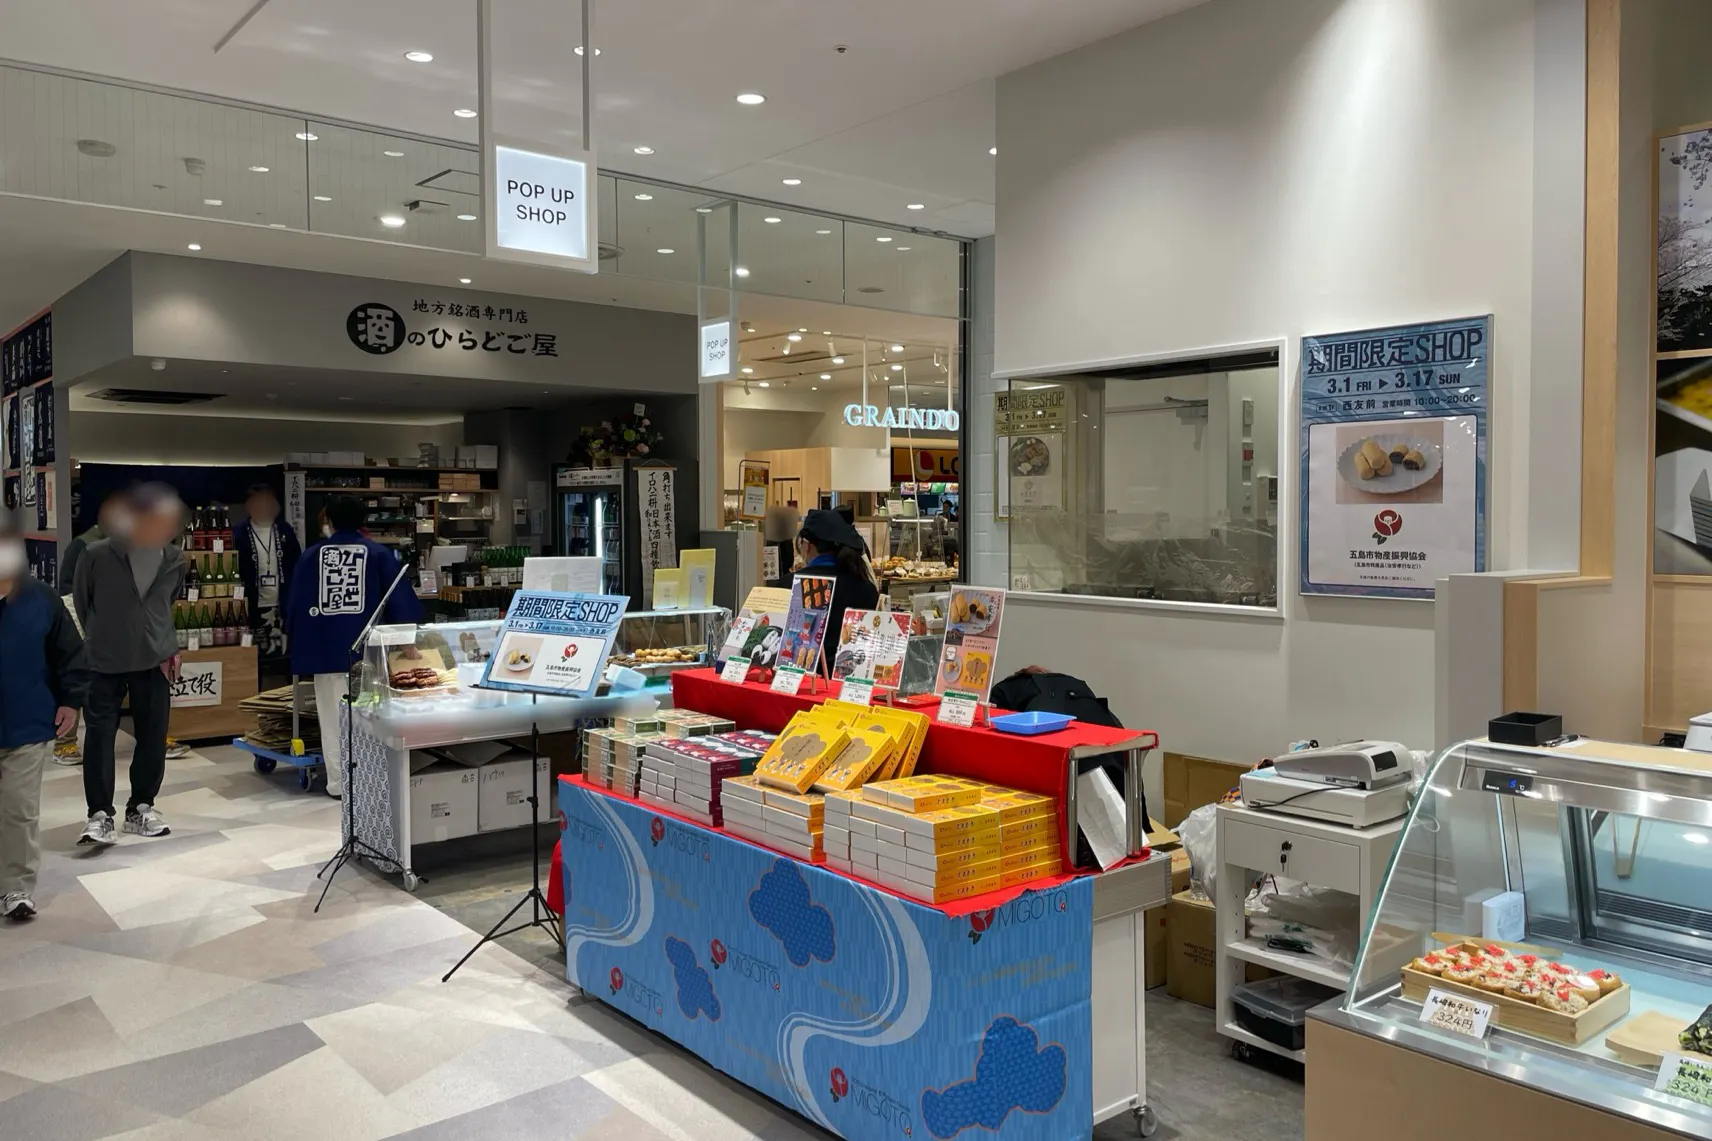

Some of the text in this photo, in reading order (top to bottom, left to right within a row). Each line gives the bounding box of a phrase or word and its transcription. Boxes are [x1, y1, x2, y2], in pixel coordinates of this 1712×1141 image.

[507, 179, 575, 204] POP UP
[516, 204, 567, 225] SHOP
[412, 299, 529, 324] 地方銘酒専門店
[707, 338, 729, 349] POP UP
[1307, 328, 1483, 374] 期間限定SHOP
[709, 350, 726, 361] SHOP
[1327, 369, 1461, 394] 3.1 FRI 3.17 SUN
[1342, 398, 1376, 411] 西友前
[1349, 550, 1427, 561] 五島市物産振興協会
[512, 596, 619, 623] 期間限定SHOP
[529, 621, 544, 630] 3.17
[169, 671, 217, 697] 立て役
[998, 890, 1068, 928] MIGOTO
[1431, 995, 1489, 1018] 長崎和牛いなり
[1437, 1011, 1473, 1030] 324円
